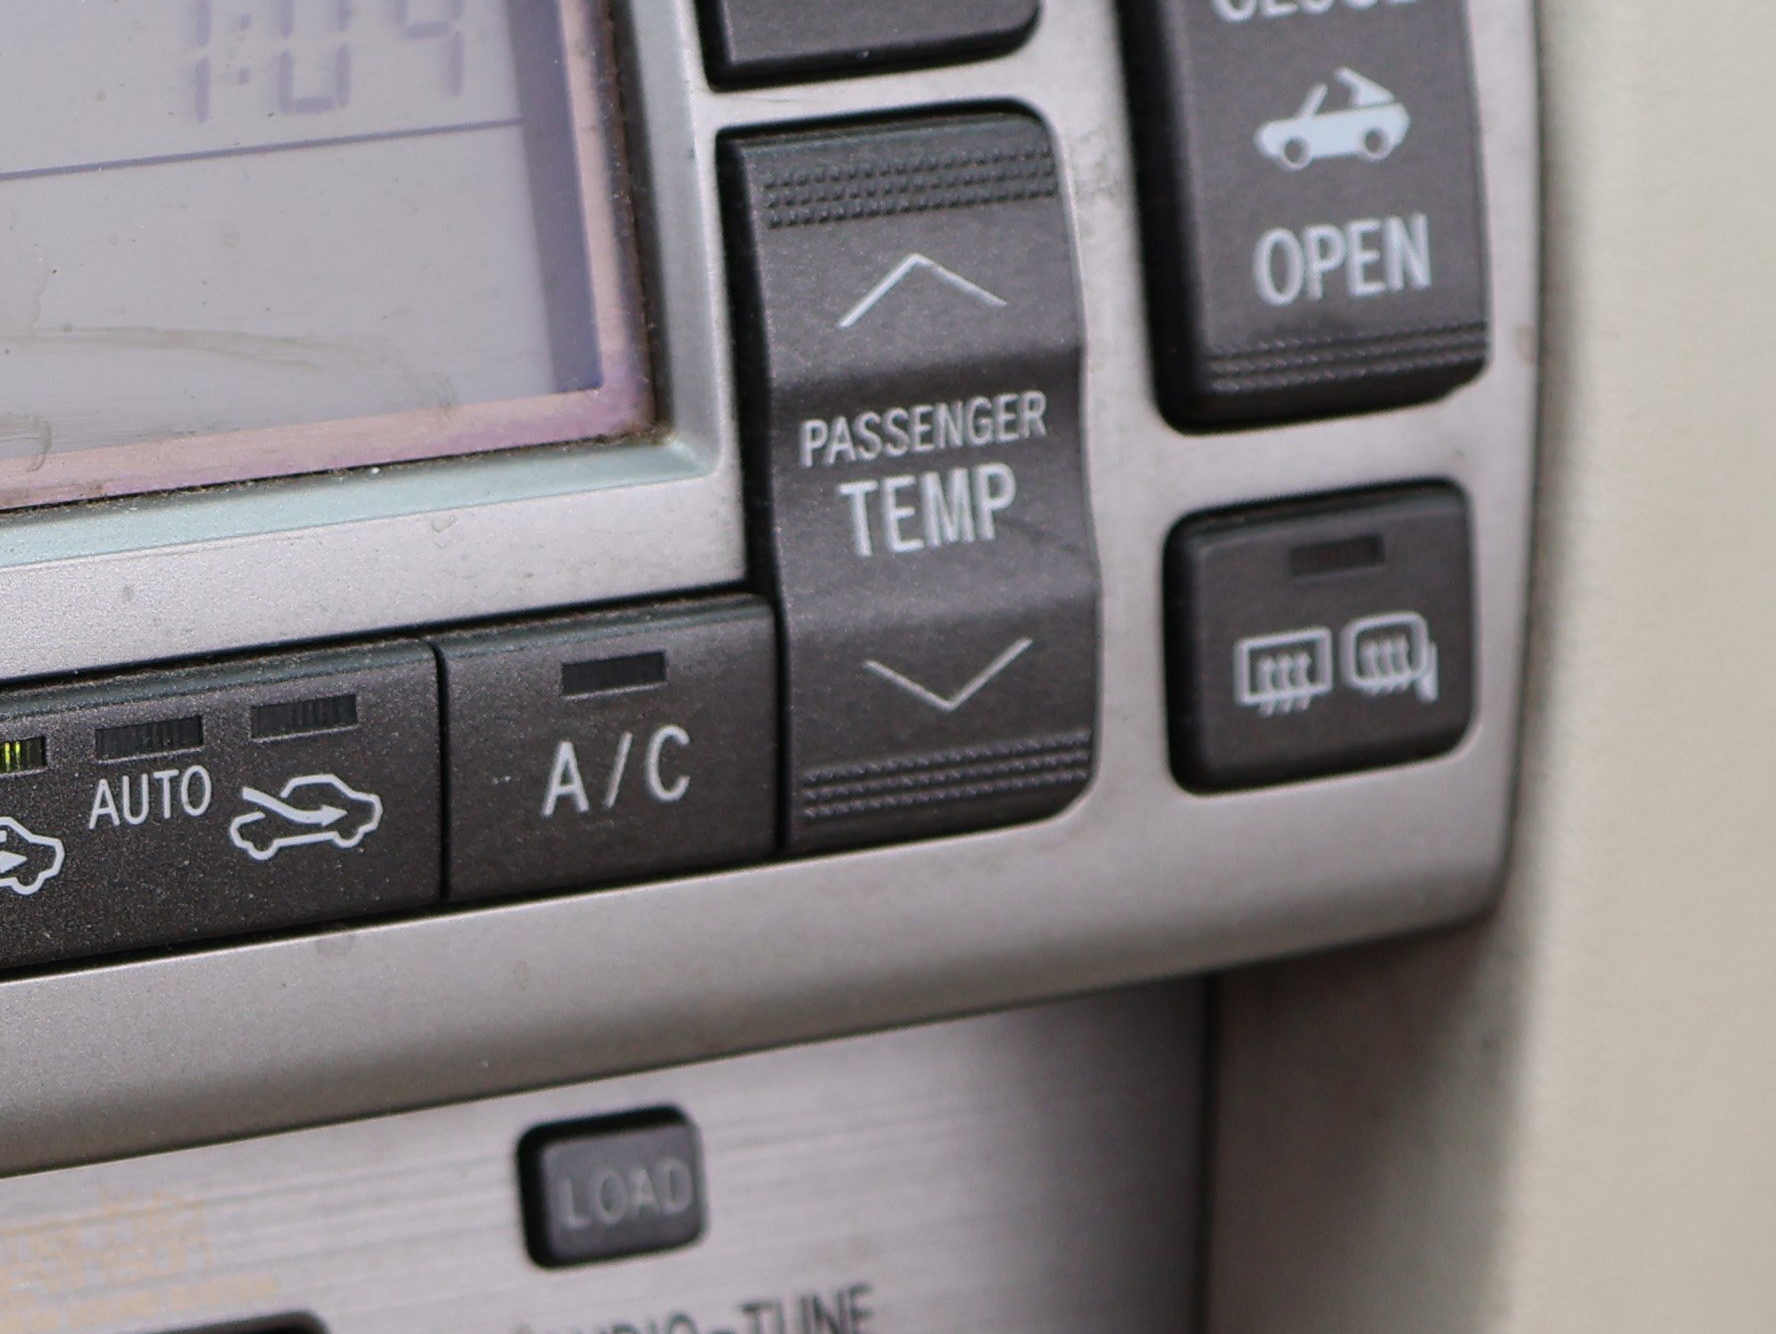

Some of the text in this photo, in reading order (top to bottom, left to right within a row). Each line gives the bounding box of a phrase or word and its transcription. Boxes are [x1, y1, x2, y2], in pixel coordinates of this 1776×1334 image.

[1253, 212, 1432, 307] OPEN
[799, 389, 1048, 467] PASSENGER
[837, 461, 1017, 557] TEMP
[86, 763, 215, 829] AUTO
[540, 724, 693, 820] A/C
[557, 1160, 695, 1230] LOAD
